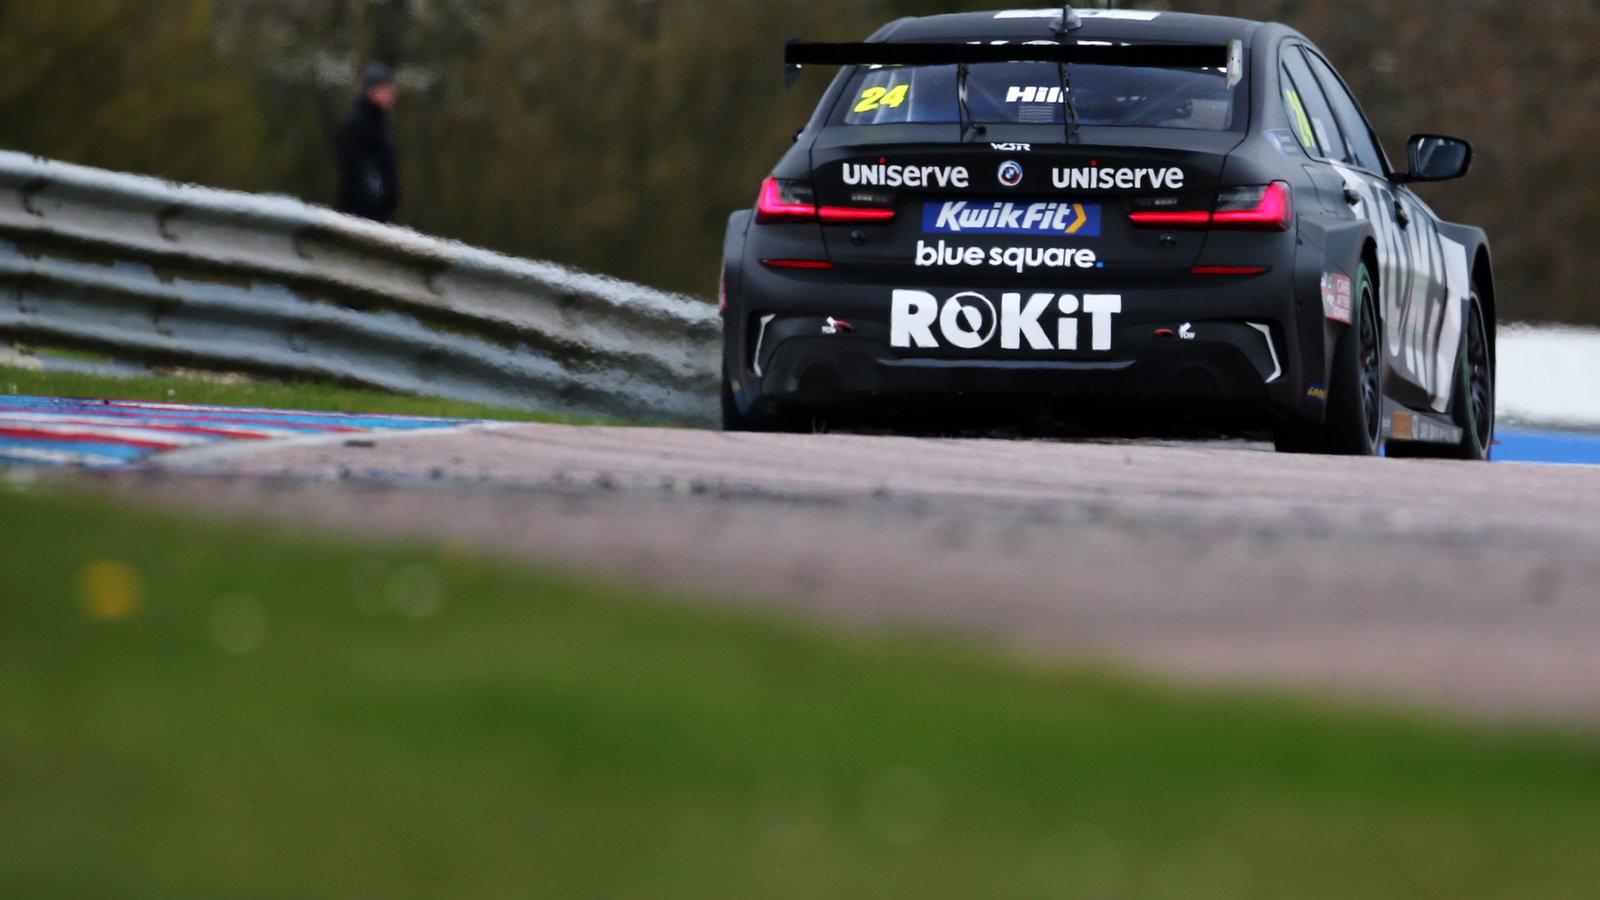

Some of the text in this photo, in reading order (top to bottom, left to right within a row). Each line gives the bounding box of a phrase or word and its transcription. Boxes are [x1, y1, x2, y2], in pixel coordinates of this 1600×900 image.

[854, 84, 909, 113] 24
[990, 142, 1031, 152] WSR
[915, 239, 985, 267] blue
